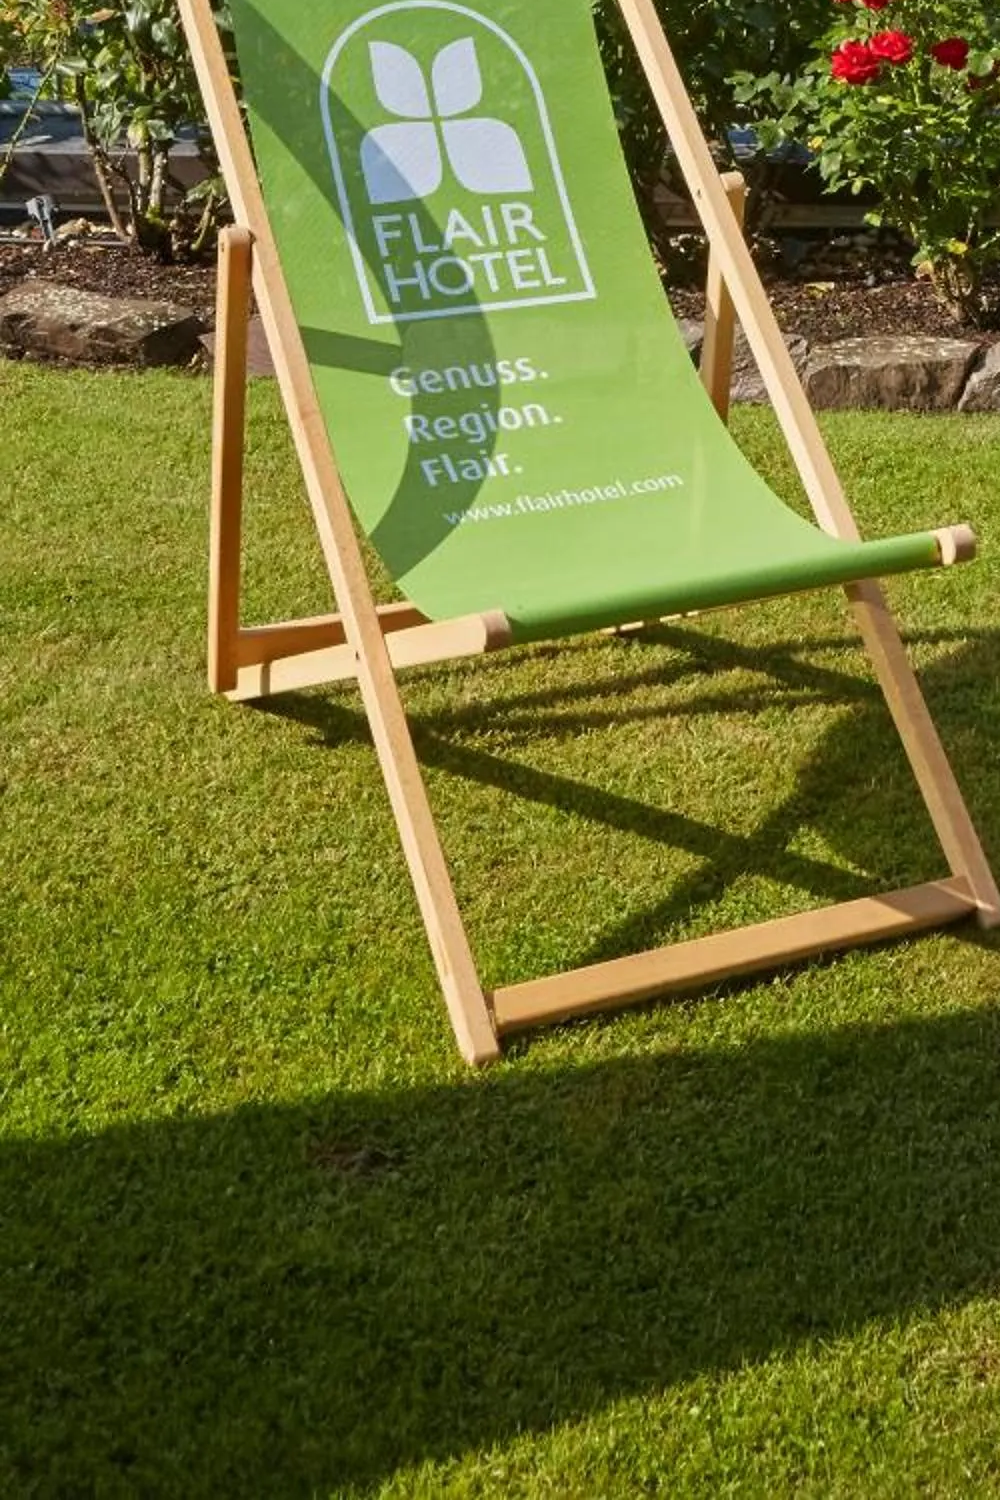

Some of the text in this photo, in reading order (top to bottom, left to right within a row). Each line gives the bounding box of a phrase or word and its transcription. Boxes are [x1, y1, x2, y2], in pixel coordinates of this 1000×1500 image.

[373, 202, 546, 256] FLAIR
[385, 249, 565, 303] HOTEL
[389, 356, 548, 398] Genuss.
[403, 402, 562, 446] Region.
[420, 450, 523, 487] Flair.
[445, 471, 682, 525] www.flairhotel.com
